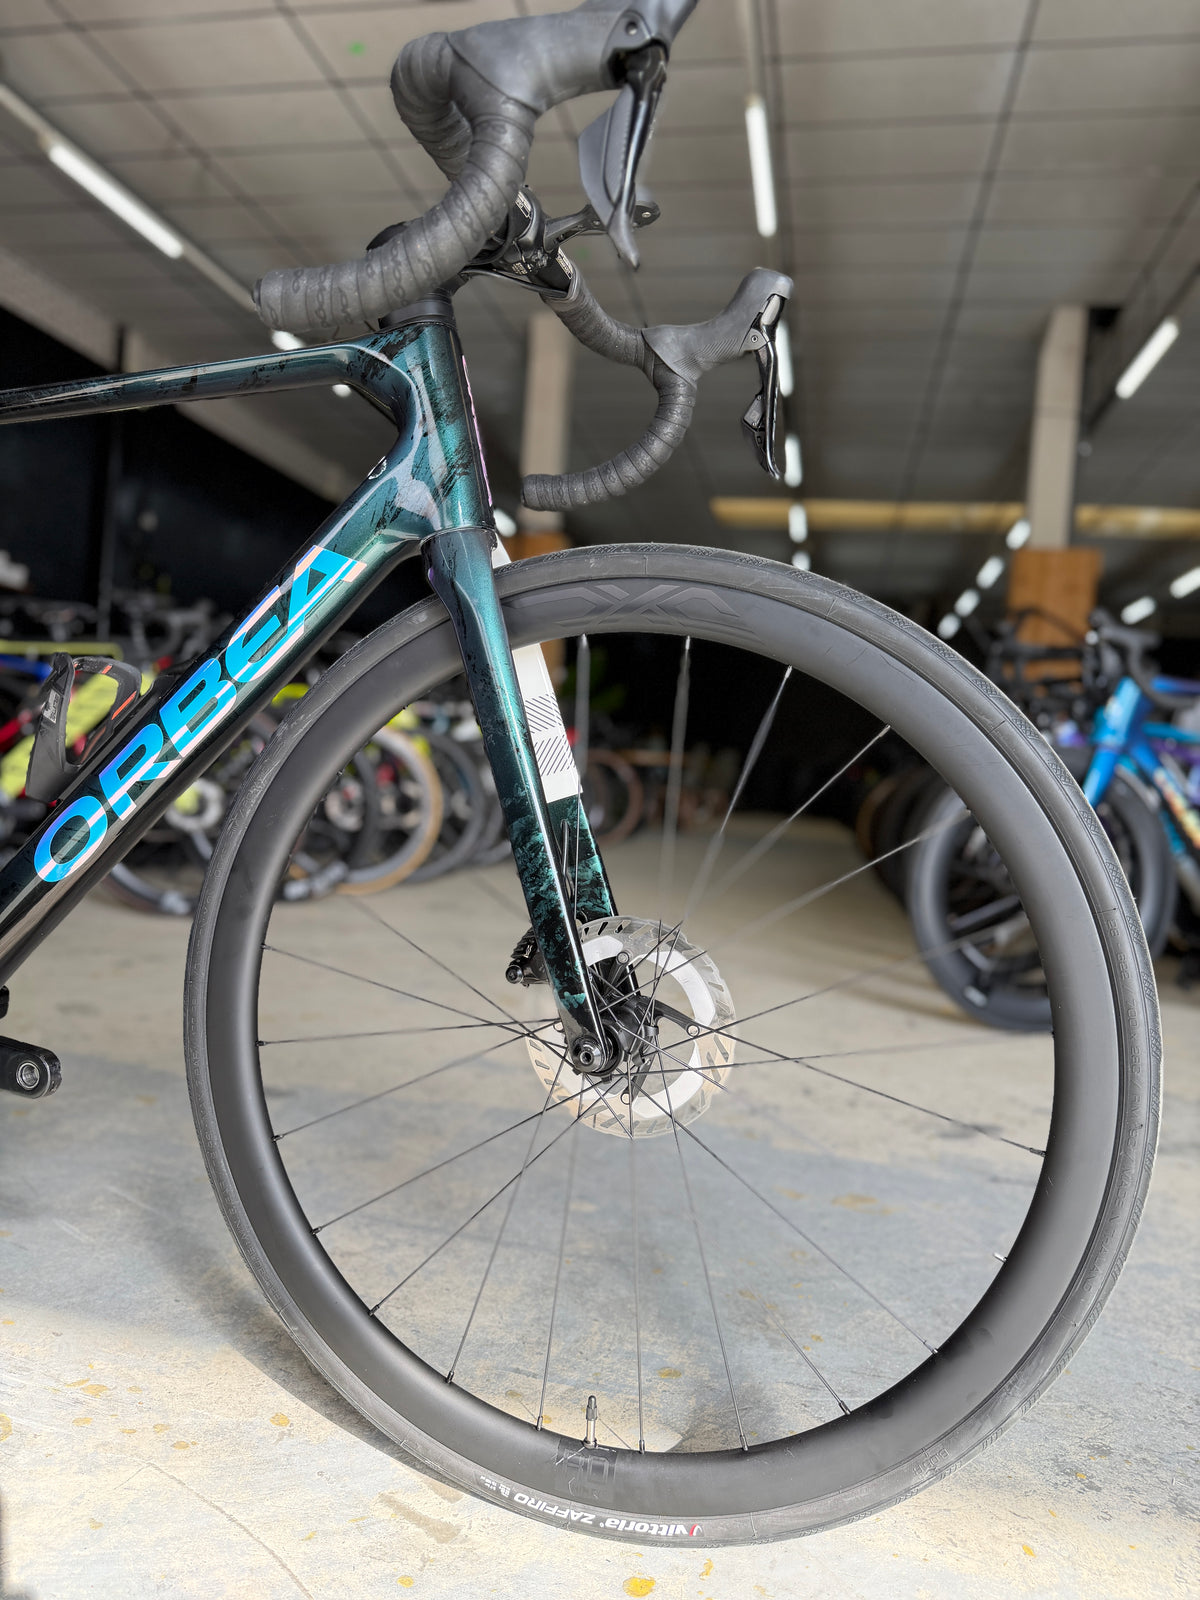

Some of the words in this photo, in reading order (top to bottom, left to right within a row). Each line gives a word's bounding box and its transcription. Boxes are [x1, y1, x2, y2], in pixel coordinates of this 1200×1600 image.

[33, 544, 367, 883] ORBEA
[1081, 1228, 1116, 1293] TAAND
[513, 1492, 596, 1525] ZAFFIRO
